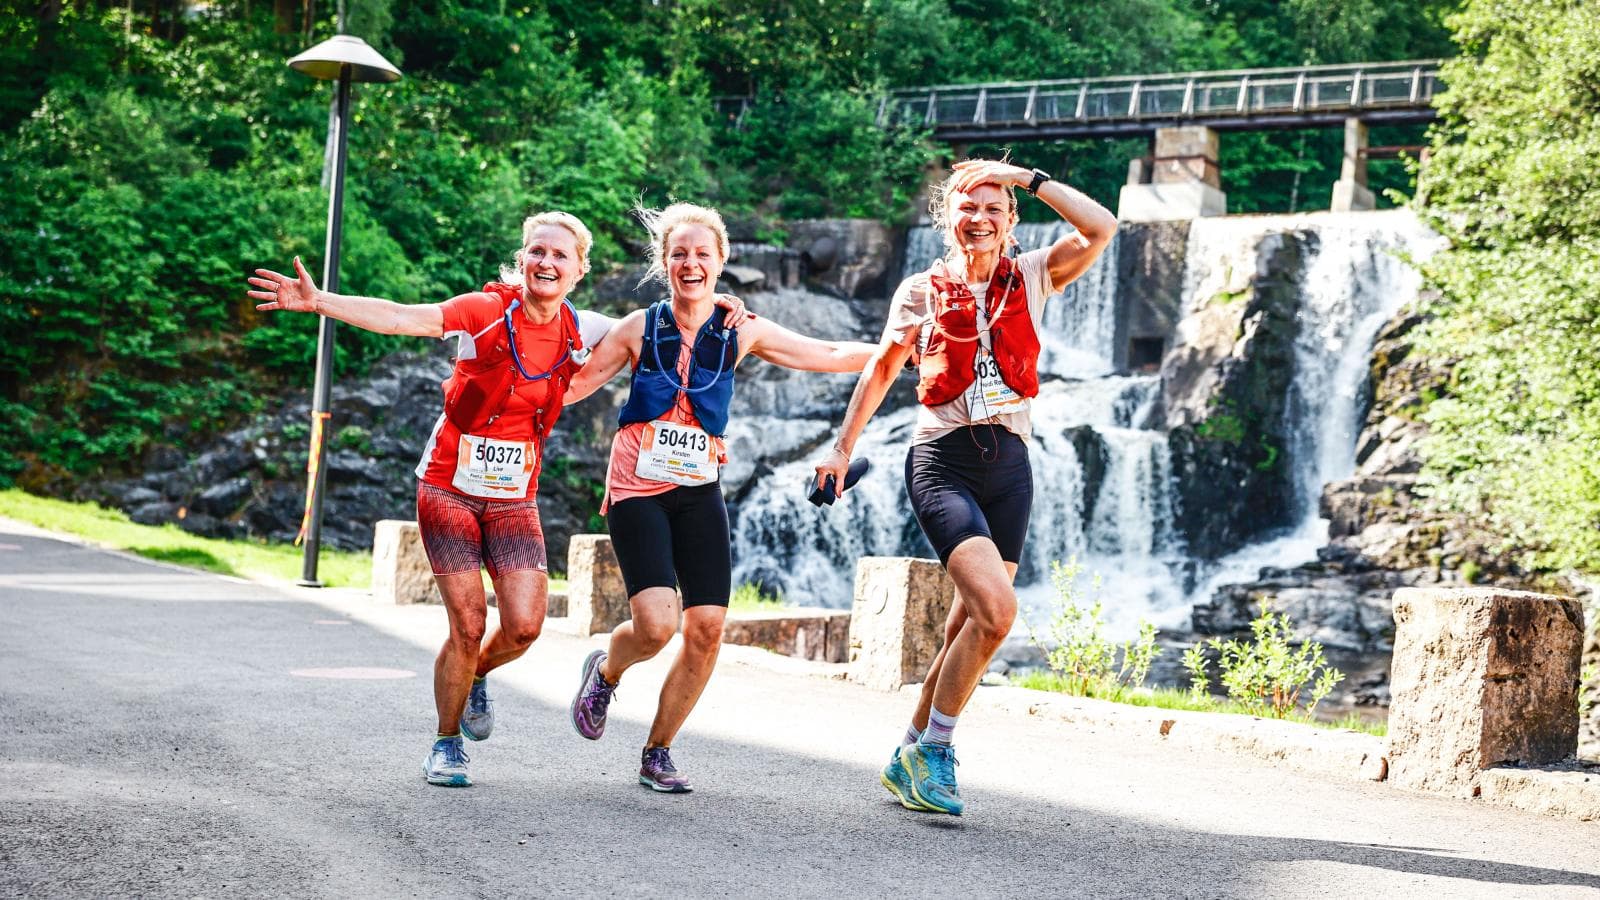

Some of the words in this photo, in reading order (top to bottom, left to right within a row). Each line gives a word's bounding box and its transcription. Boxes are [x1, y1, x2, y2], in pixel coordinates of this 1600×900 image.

[978, 360, 998, 379] 03
[659, 428, 706, 451] 50413
[475, 443, 522, 465] 50372
[672, 450, 690, 458] Kirsten
